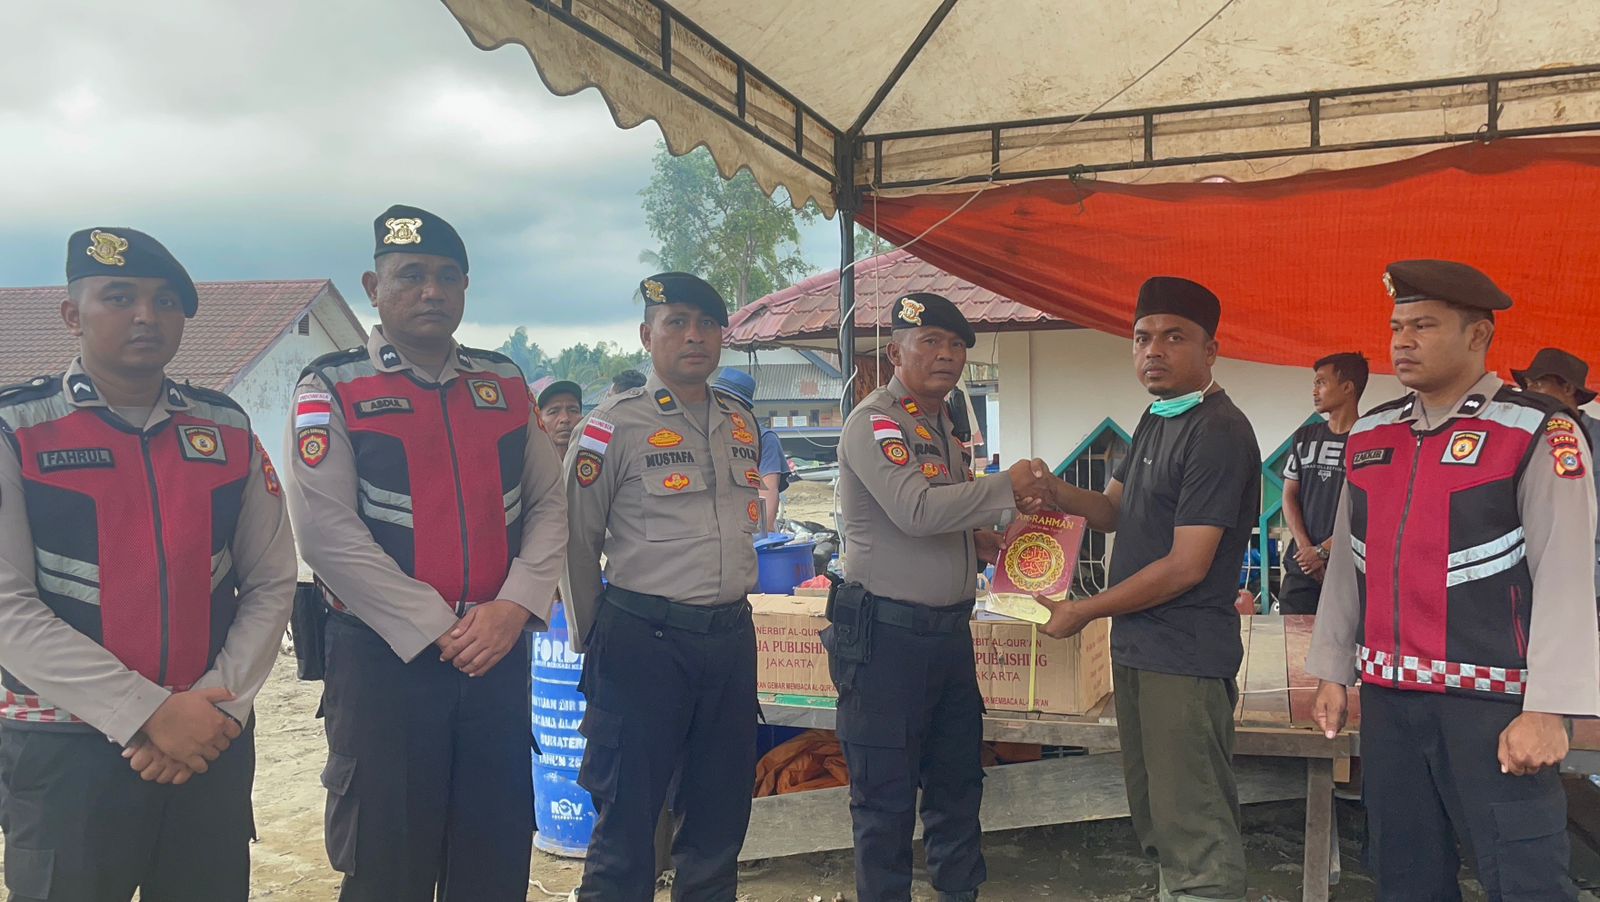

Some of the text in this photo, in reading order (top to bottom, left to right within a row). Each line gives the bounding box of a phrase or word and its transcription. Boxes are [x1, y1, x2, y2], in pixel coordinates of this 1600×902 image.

[370, 399, 402, 410] ABDUL
[47, 450, 108, 466] FAHRUL
[645, 451, 695, 468] MUSTAFA
[766, 658, 815, 669] JAKARTA
[991, 697, 1018, 706] MEMBACA
